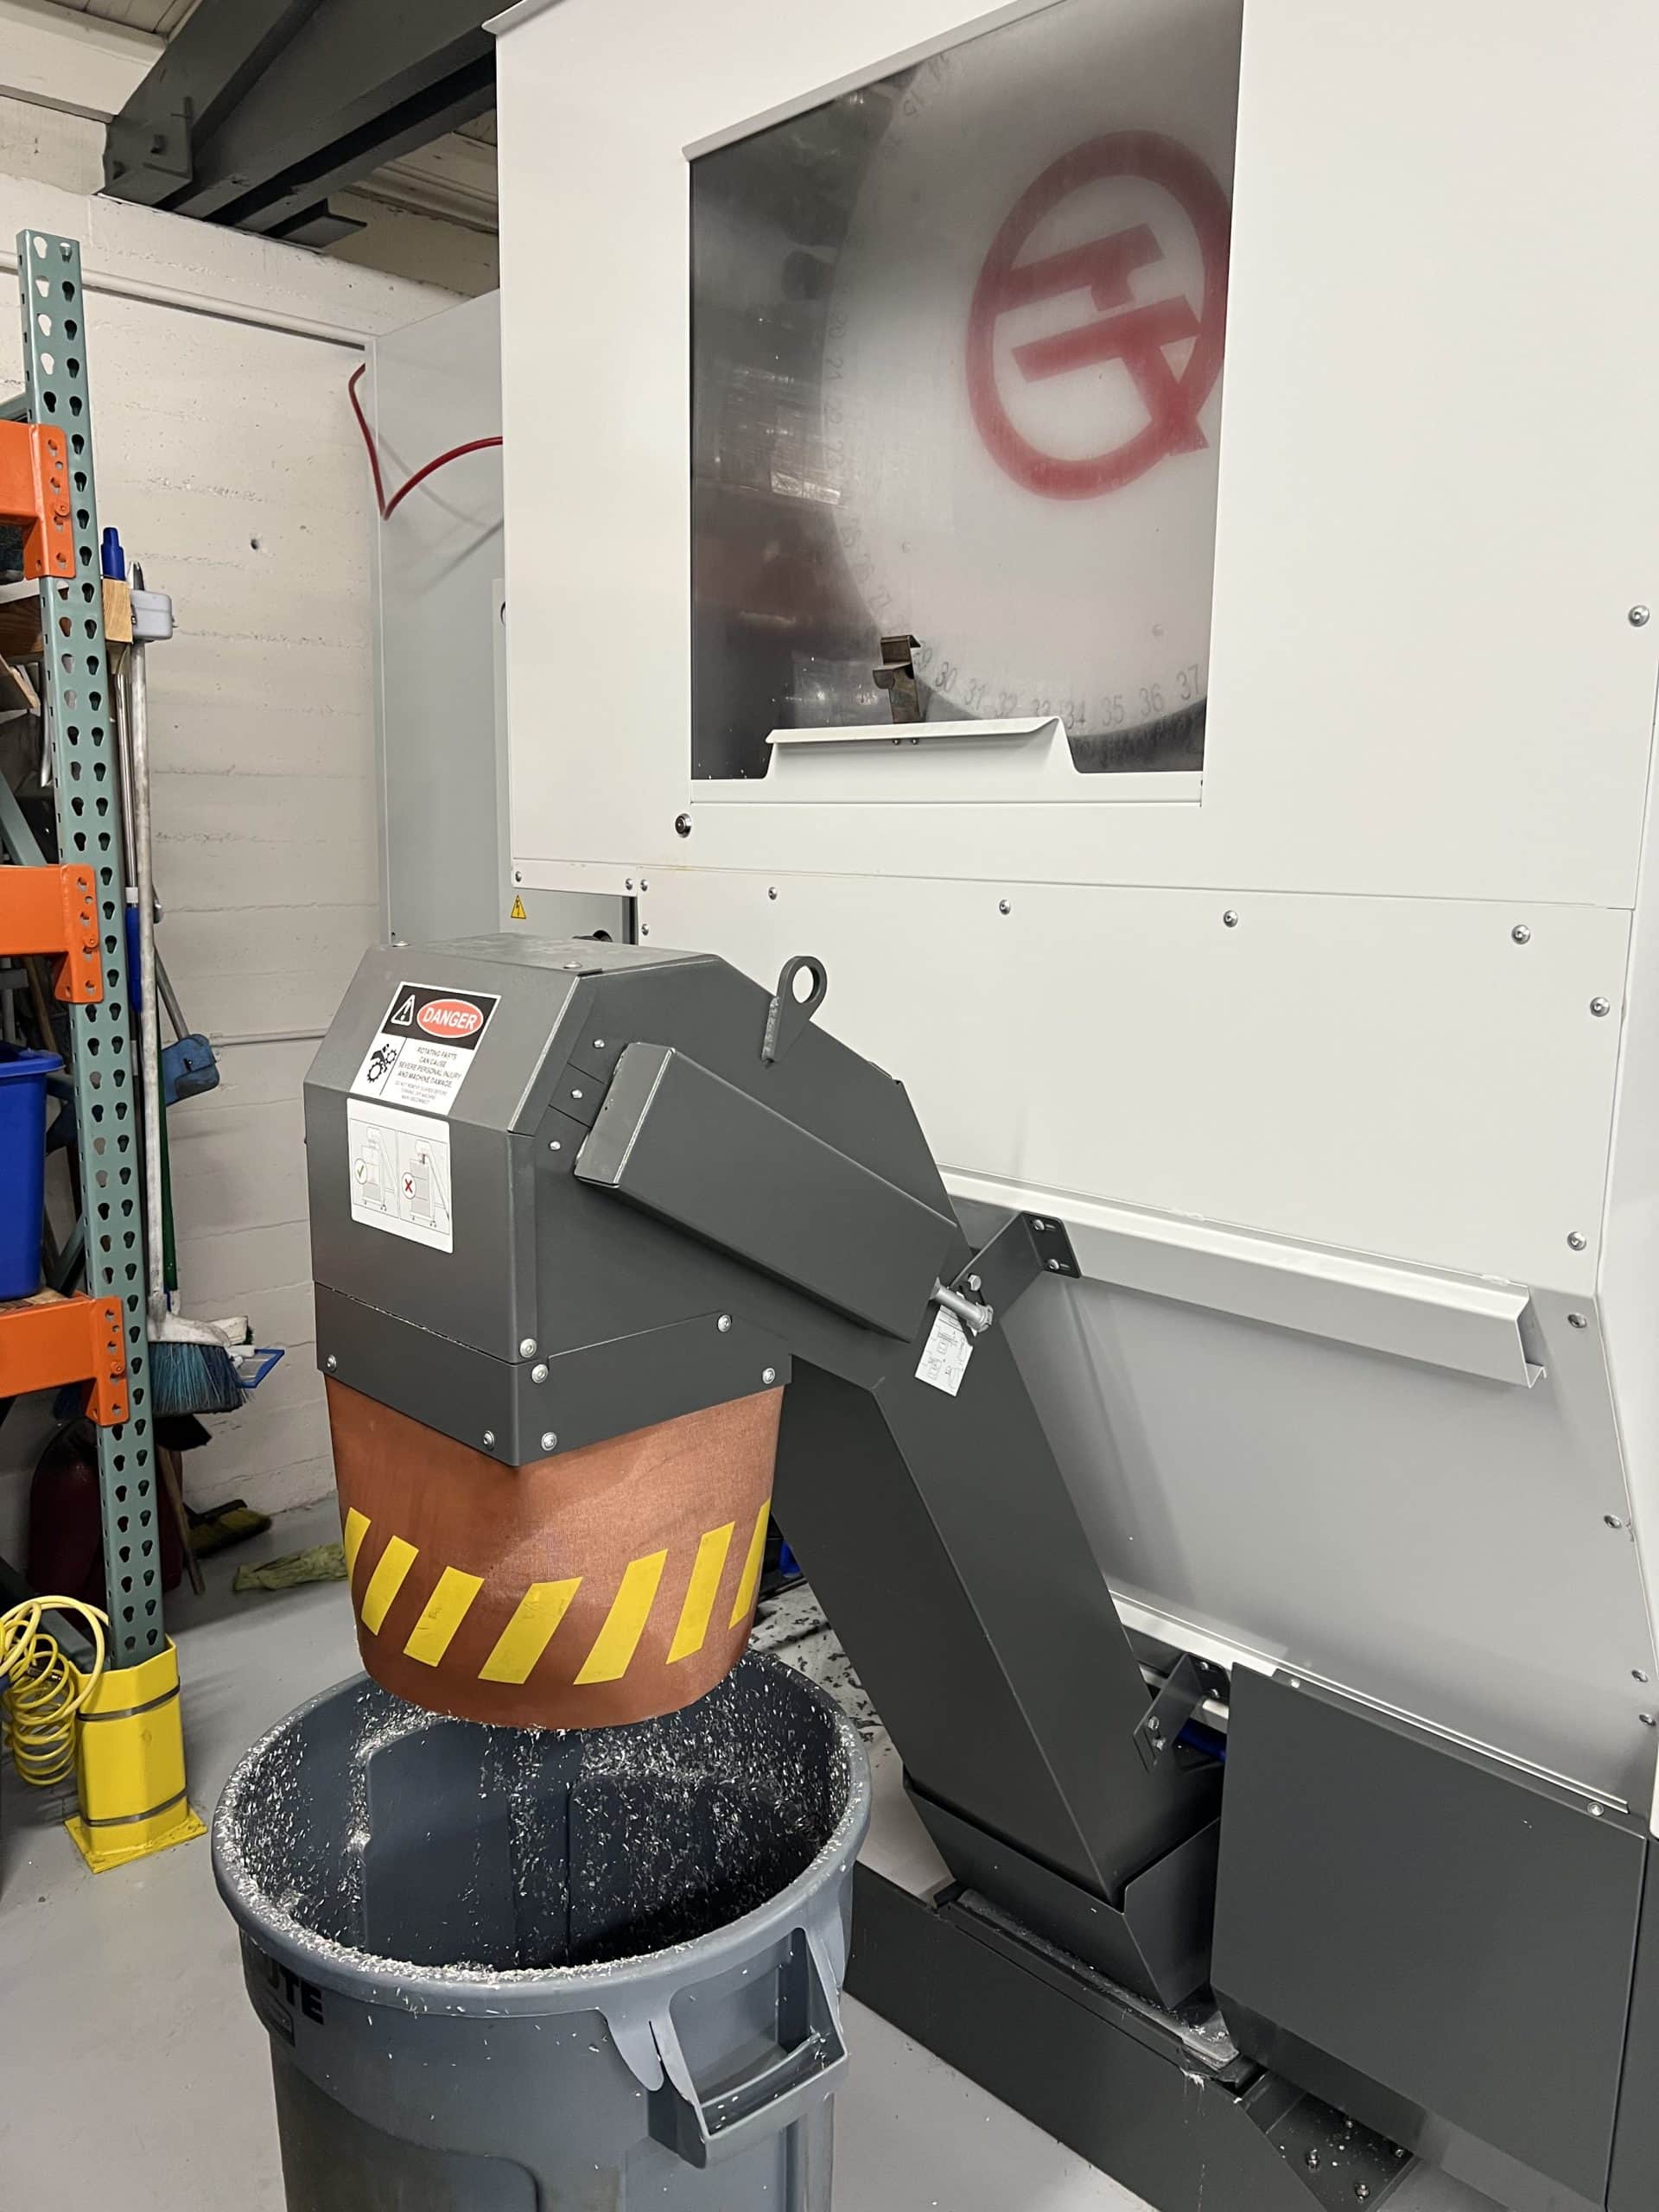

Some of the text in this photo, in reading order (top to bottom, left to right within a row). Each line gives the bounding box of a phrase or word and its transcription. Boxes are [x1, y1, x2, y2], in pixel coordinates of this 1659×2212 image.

[935, 661, 957, 693] 30
[1175, 663, 1199, 701] 37
[963, 677, 986, 711] 31
[1138, 682, 1163, 717] 36
[1062, 699, 1086, 729] 34
[1100, 694, 1124, 727] 35
[422, 1007, 478, 1031] DANGER
[417, 1046, 457, 1061] ROTATING PARTS
[430, 1058, 447, 1068] CAUSE
[399, 1061, 461, 1079] SEVERE PERSONAL INJURY
[409, 1073, 430, 1084] MACHINE
[430, 1077, 453, 1088] DAMAGE
